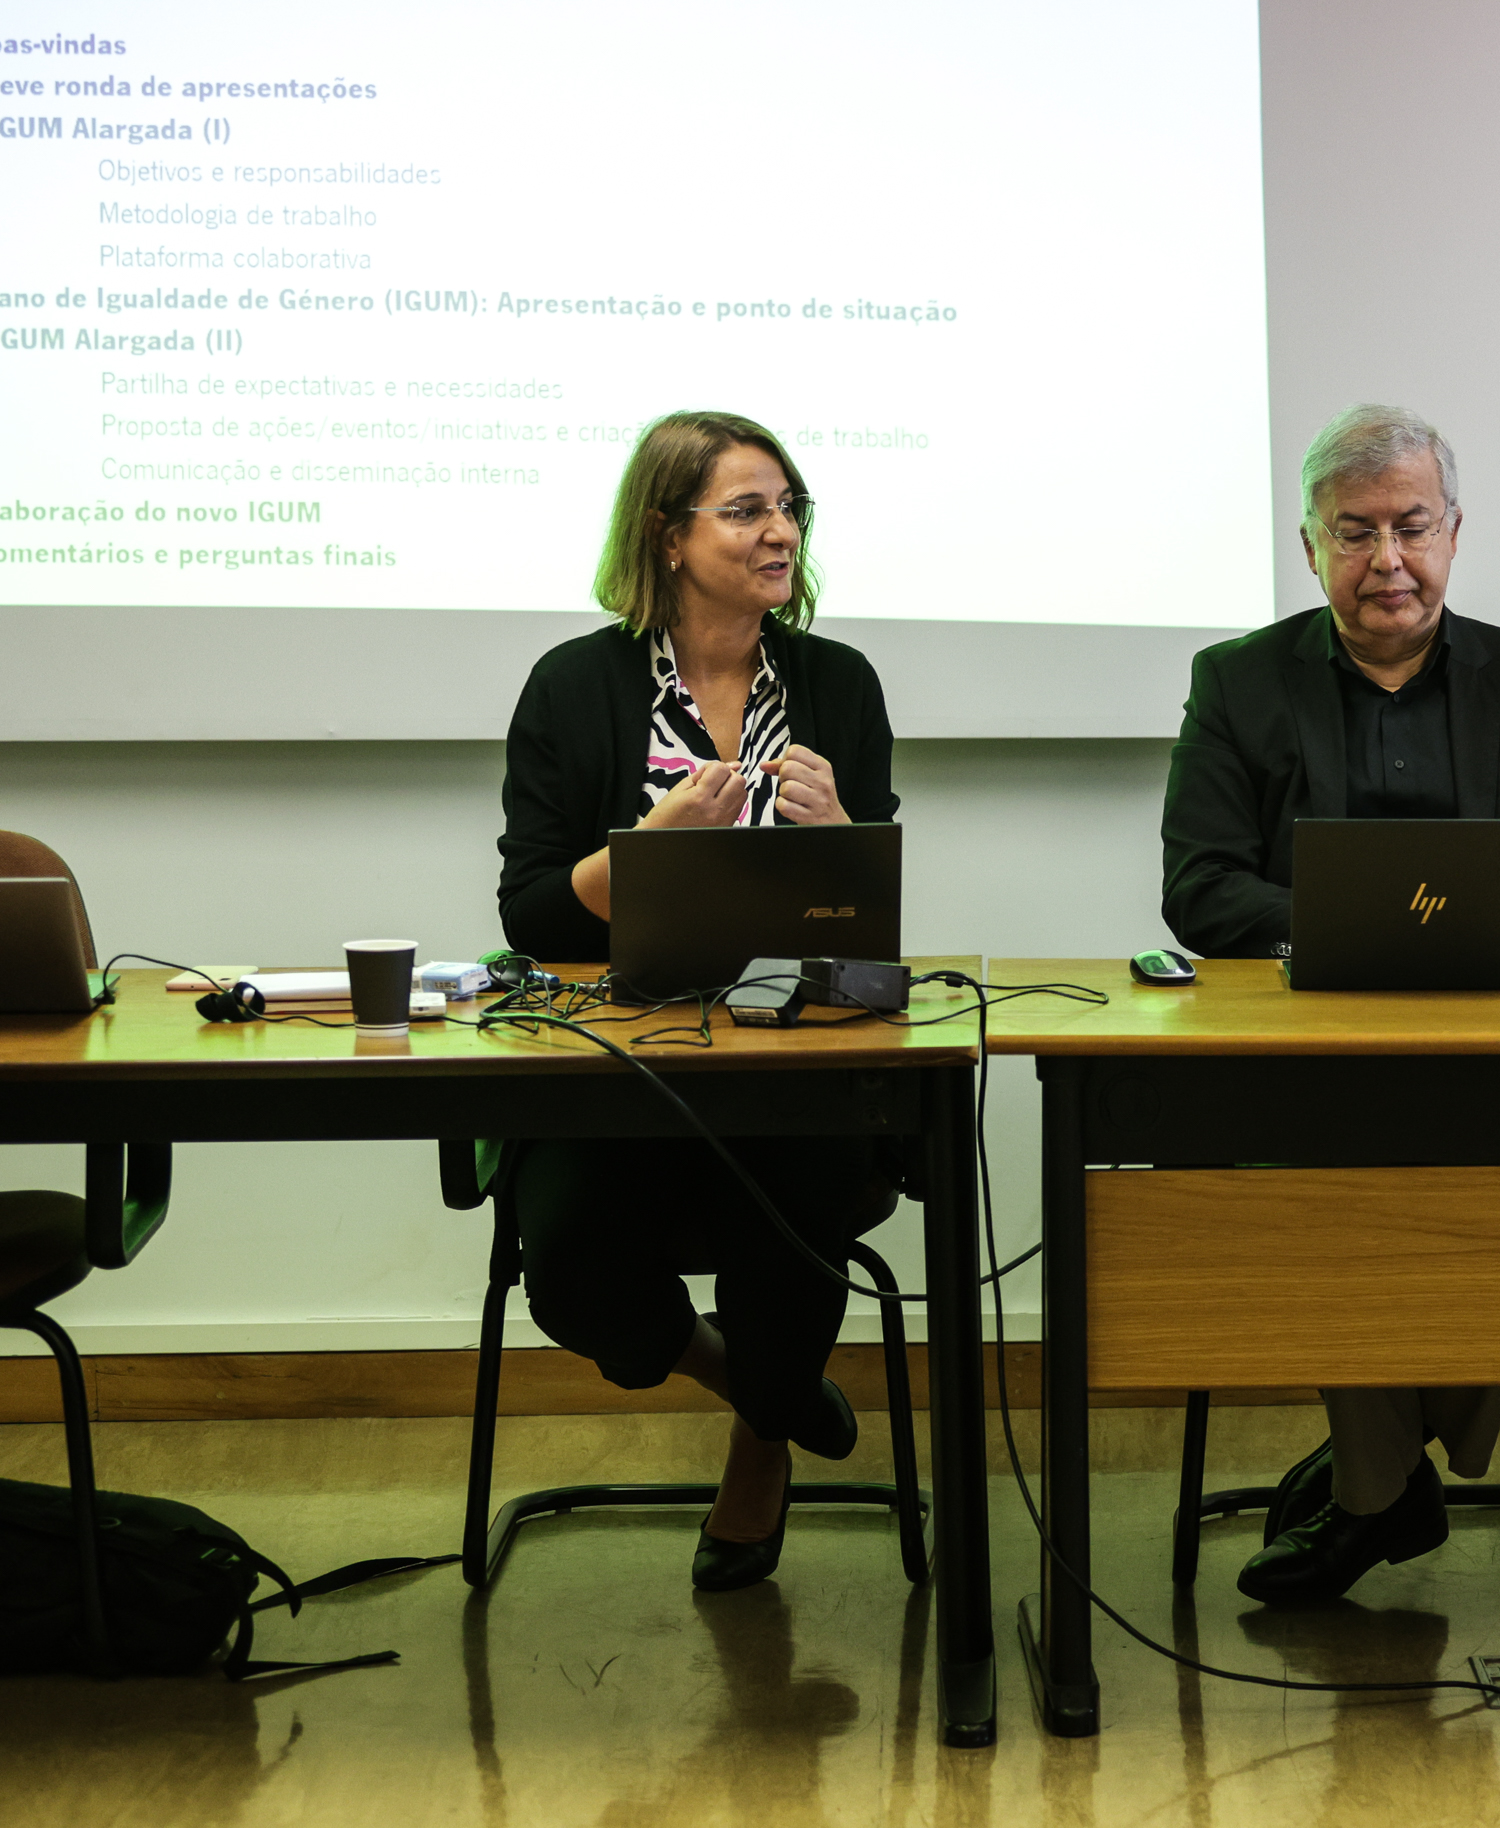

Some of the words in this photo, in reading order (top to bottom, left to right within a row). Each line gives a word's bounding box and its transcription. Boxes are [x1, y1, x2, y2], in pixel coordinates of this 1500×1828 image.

[0, 32, 127, 56] as-vindas
[54, 74, 132, 97] ronda
[140, 74, 173, 98] de
[181, 77, 377, 104] apresentações
[72, 117, 193, 146] Alargada
[203, 117, 231, 146] (I)
[98, 158, 203, 187] Objetivos
[212, 166, 224, 182] e
[234, 162, 442, 190] responsabilidades
[99, 201, 237, 230] Metodologia
[247, 204, 273, 226] de
[282, 204, 377, 227] trabalho
[100, 244, 224, 269] Plataforma
[233, 246, 371, 270] colaborativa
[55, 286, 87, 310] de
[97, 286, 228, 315] Igualdade
[237, 288, 269, 311] de
[278, 287, 374, 312] Género
[385, 288, 487, 318] (IGUM):
[497, 290, 682, 321] Apresentação
[692, 301, 706, 317] e
[716, 297, 791, 322] ponto
[801, 296, 833, 320] de
[843, 298, 957, 328] situação
[1, 327, 65, 350] GUM
[74, 327, 195, 356] Alargada
[206, 328, 243, 356] (II)
[101, 371, 188, 395] Partilha
[198, 373, 225, 396] de
[235, 375, 375, 403] expectativas
[385, 382, 397, 398] e
[406, 377, 564, 400] necessidades
[102, 413, 202, 441] Proposta
[211, 415, 239, 438] de
[248, 416, 547, 442] ações/eventos/iniciativas
[556, 426, 568, 441] e
[578, 422, 646, 447] criaç
[796, 425, 823, 448] de
[833, 426, 929, 450] trabalho
[101, 456, 261, 486] Comunicação
[270, 465, 283, 481] e
[292, 459, 451, 489] disseminação
[461, 462, 540, 486] interna
[134, 499, 166, 523] do
[176, 506, 238, 523] novo
[249, 500, 321, 525] IGUM
[154, 548, 169, 564] e
[179, 545, 314, 571] perguntas
[323, 543, 397, 568] finais
[803, 907, 856, 918] ASUS
